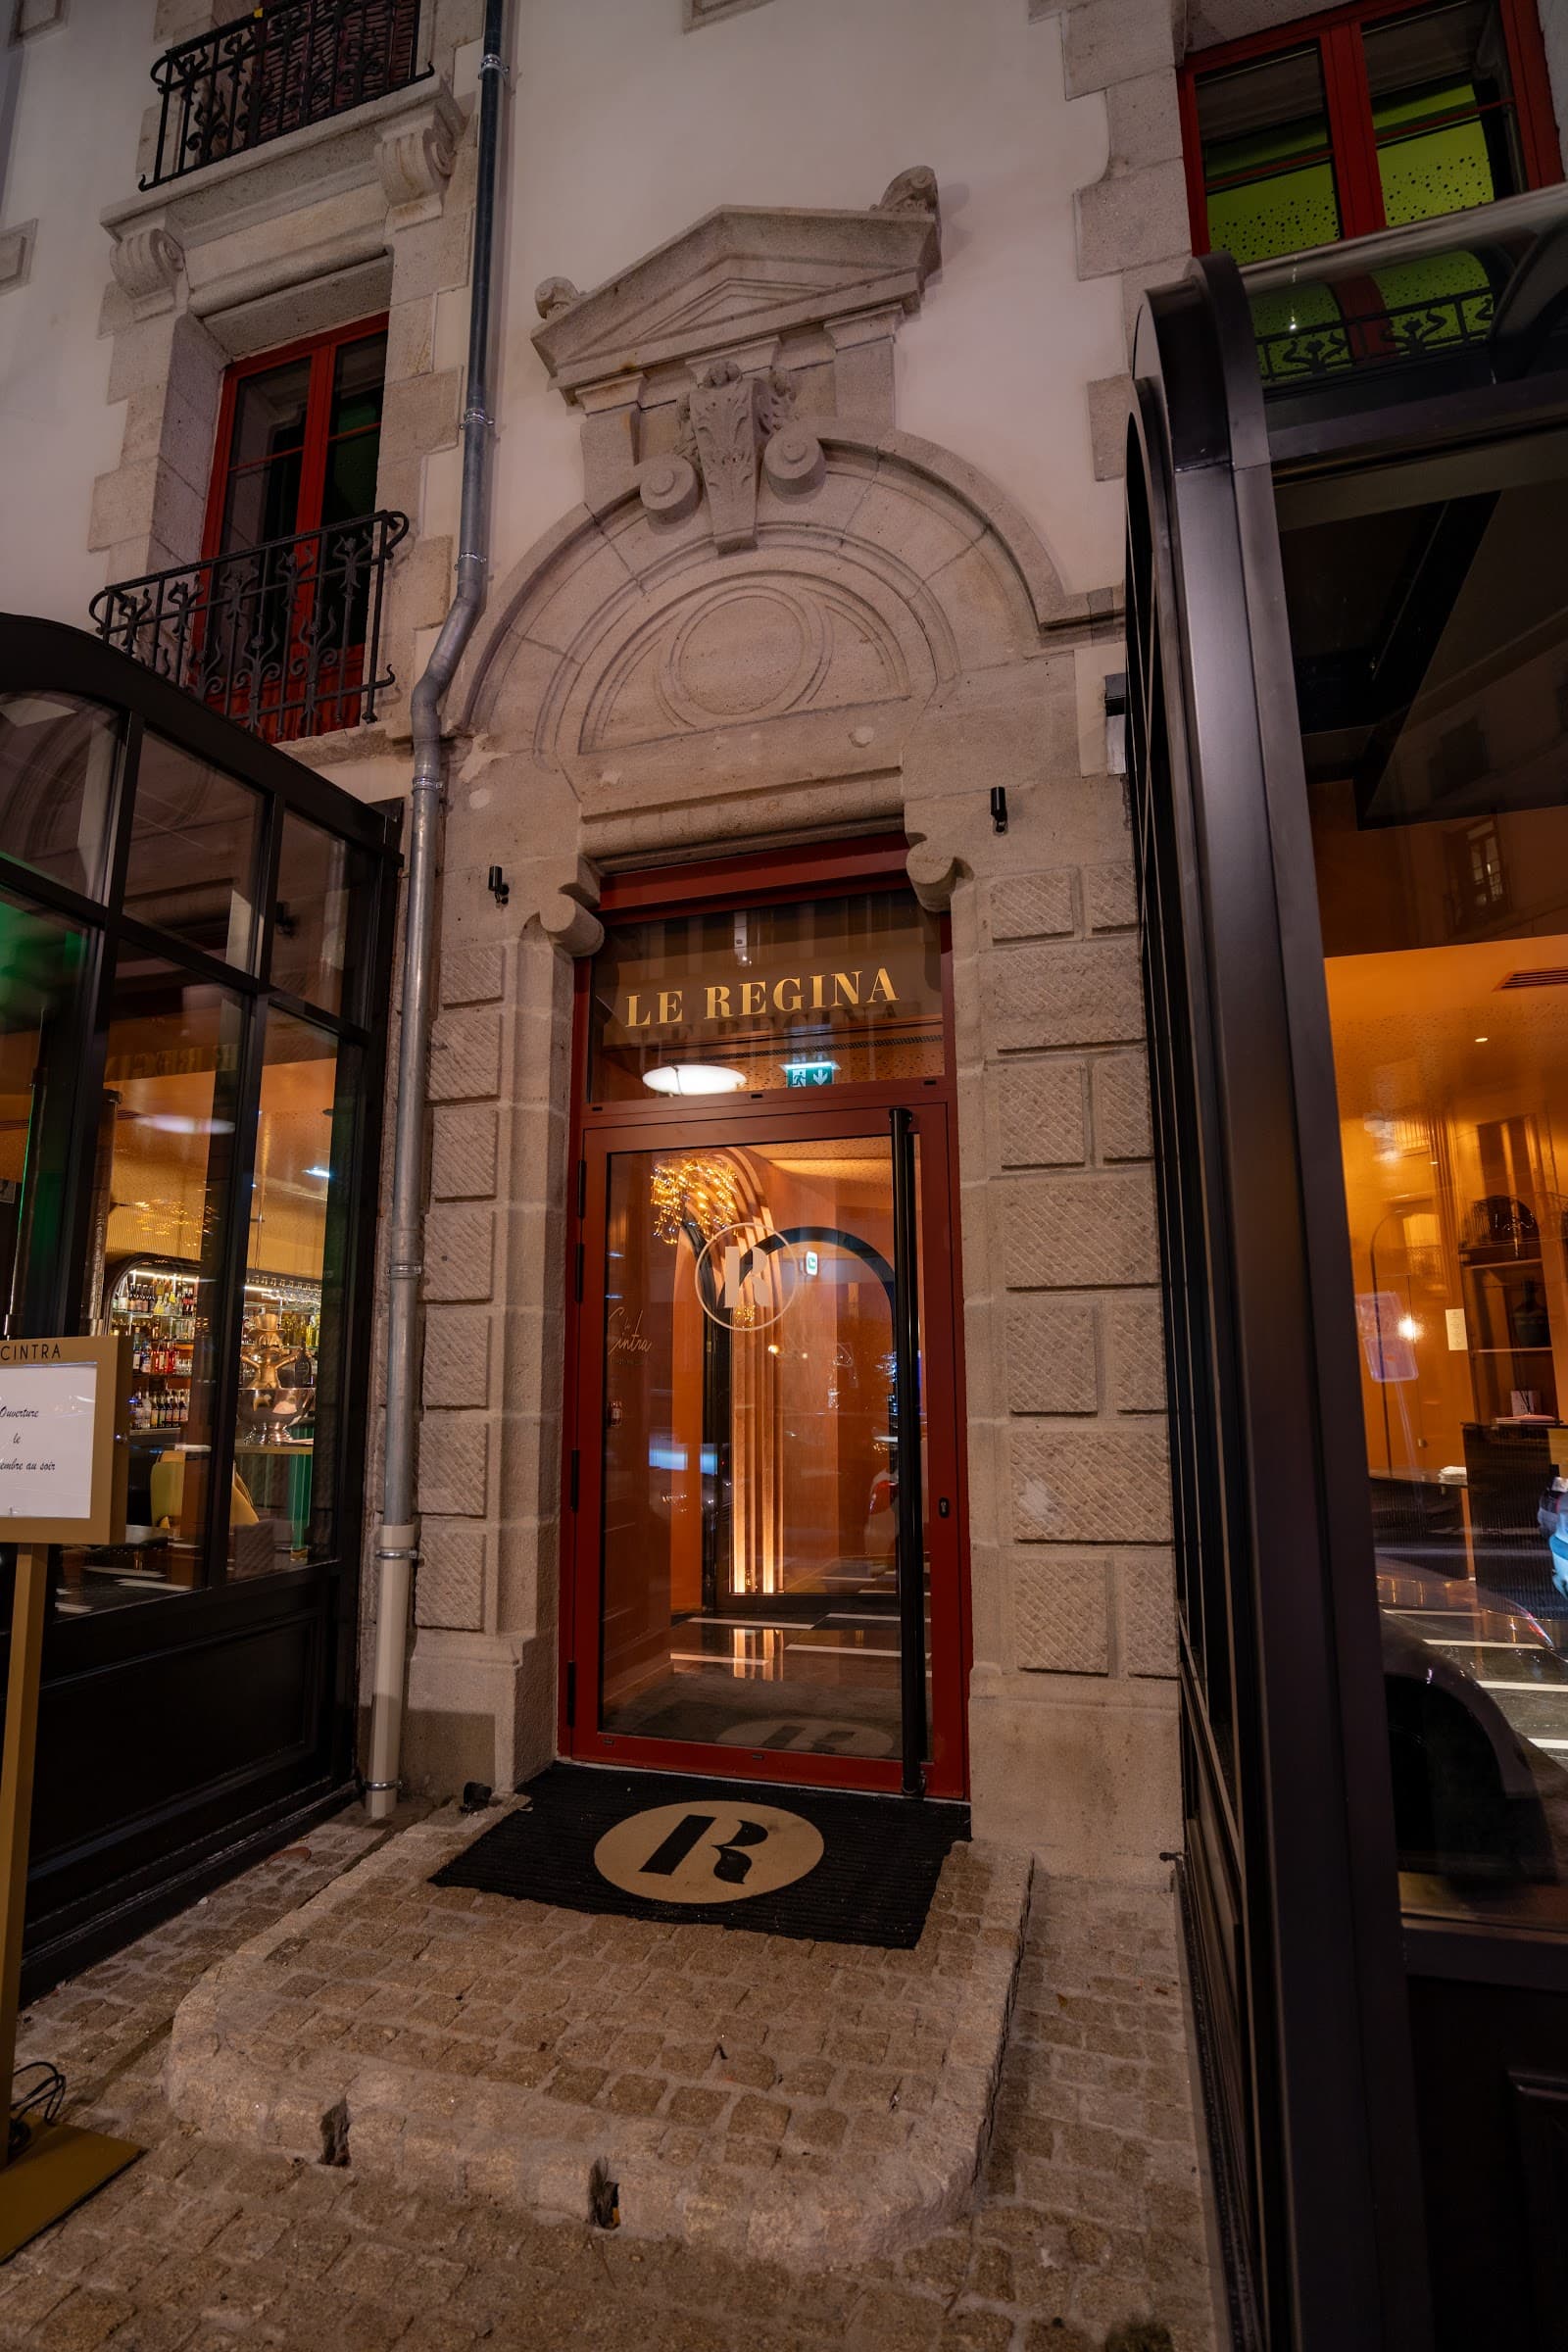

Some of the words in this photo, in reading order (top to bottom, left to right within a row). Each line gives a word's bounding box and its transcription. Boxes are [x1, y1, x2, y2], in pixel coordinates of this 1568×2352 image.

[625, 991, 683, 1028] LE
[704, 967, 901, 1020] REGINA
[724, 1246, 770, 1308] R
[0, 1343, 61, 1361] CINTRA
[0, 1405, 39, 1418] Ouverture
[13, 1433, 21, 1445] le
[25, 1462, 37, 1471] au
[39, 1461, 56, 1471] soir
[638, 1814, 769, 1885] R
